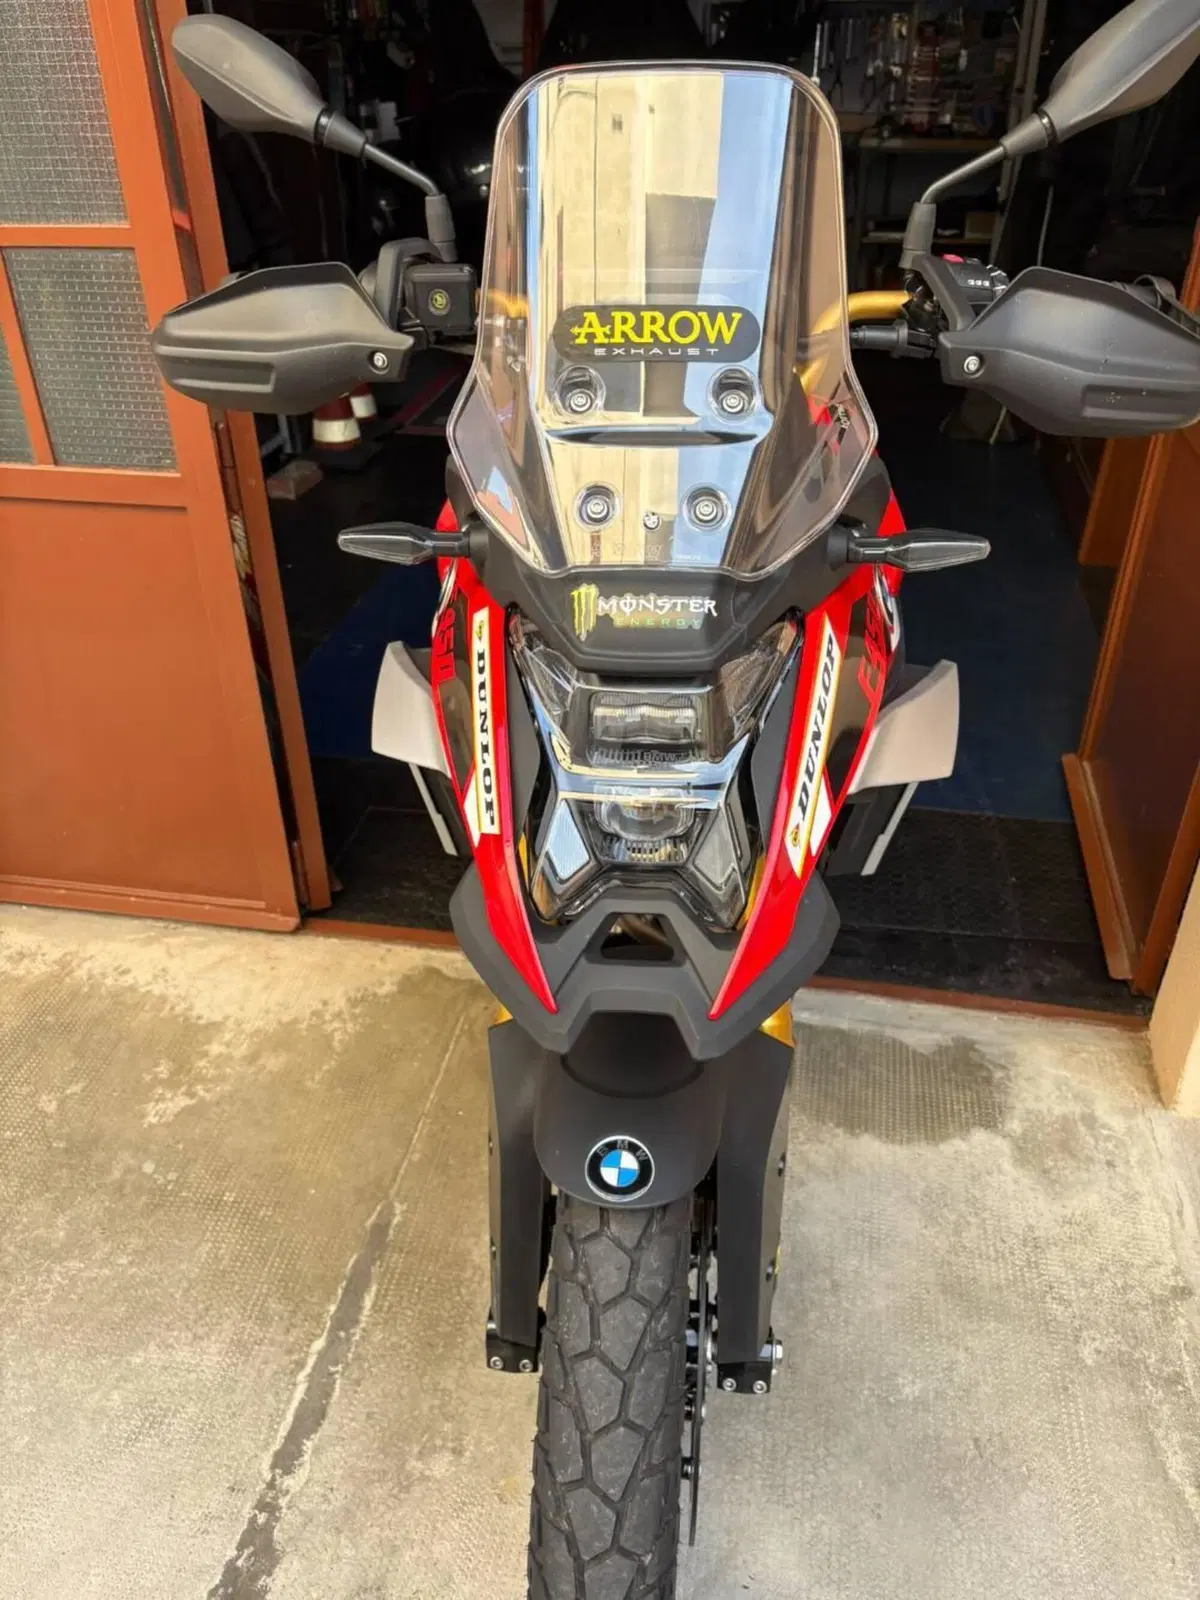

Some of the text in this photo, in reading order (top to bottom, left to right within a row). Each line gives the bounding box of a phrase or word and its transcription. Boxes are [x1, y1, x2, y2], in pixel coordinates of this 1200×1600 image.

[570, 310, 743, 345] ARROW
[593, 347, 719, 356] EXHAUST
[597, 595, 718, 617] MONSTER
[615, 617, 701, 627] ENERGY
[799, 632, 835, 821] DUNLOP
[475, 650, 496, 827] DUNLOP
[596, 1139, 649, 1161] BMW
